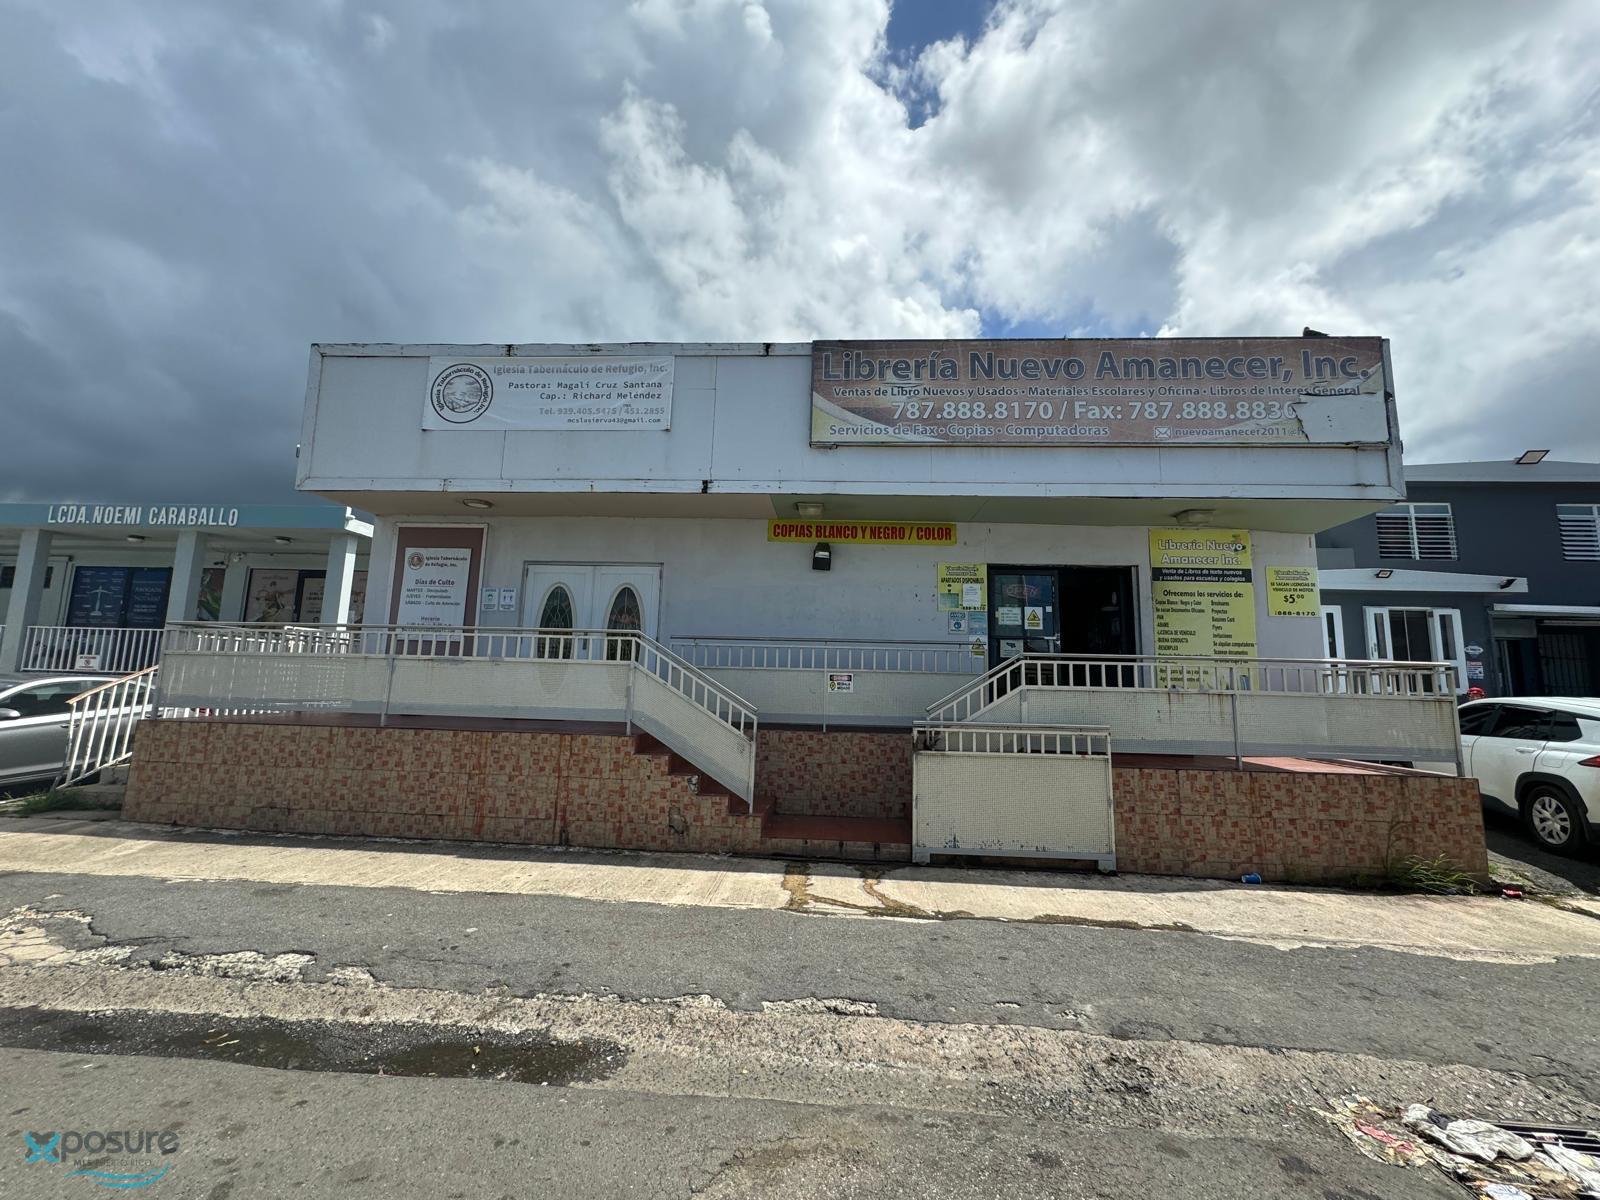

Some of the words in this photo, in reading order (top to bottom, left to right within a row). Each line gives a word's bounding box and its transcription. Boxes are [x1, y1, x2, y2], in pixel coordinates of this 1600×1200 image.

[493, 365, 525, 376] Iglesia
[591, 365, 603, 374] de
[822, 350, 960, 382] Librería
[968, 351, 1086, 382] Nuevo
[1095, 350, 1293, 383] Amanecer,
[1302, 349, 1370, 380] Inc.
[508, 381, 551, 389] Pastora:
[595, 381, 618, 389] Cruz
[623, 381, 662, 389] Santana
[539, 391, 567, 401] Cap.:
[573, 391, 612, 400] Richard
[834, 387, 871, 397] Ventas
[874, 386, 888, 397] de
[891, 386, 920, 397] Libro
[923, 386, 965, 397] Nuevos
[967, 389, 975, 399] y
[977, 386, 1019, 397] Usados
[1028, 386, 1089, 397] Materiales
[1092, 386, 1146, 397] Escolares
[1149, 389, 1156, 399] y
[1159, 385, 1200, 396] Oficina
[1210, 386, 1248, 396] Libros
[1250, 385, 1266, 396] de
[1312, 385, 1361, 396] General
[891, 401, 1054, 420] 787.888.8170
[1074, 401, 1122, 420] Fax:
[829, 424, 890, 437] Servicios
[892, 424, 910, 437] de
[913, 424, 936, 437] Fax
[947, 424, 994, 439] Copias
[1006, 423, 1110, 438] Computadoras
[48, 505, 90, 524] LCDA.
[92, 506, 142, 525] NOEMI
[148, 507, 239, 527] CARABALLO
[773, 523, 813, 538] COPIAS
[815, 524, 858, 539] BLANCO
[859, 525, 868, 539] Y
[870, 526, 906, 540] NEGRO
[916, 527, 952, 541] COLOR
[1206, 540, 1243, 551] Nuevo
[1161, 553, 1220, 565] Amanecer
[1222, 554, 1242, 565] Inc.
[1163, 589, 1196, 597] Ofrecemos
[1206, 590, 1232, 598] servicios
